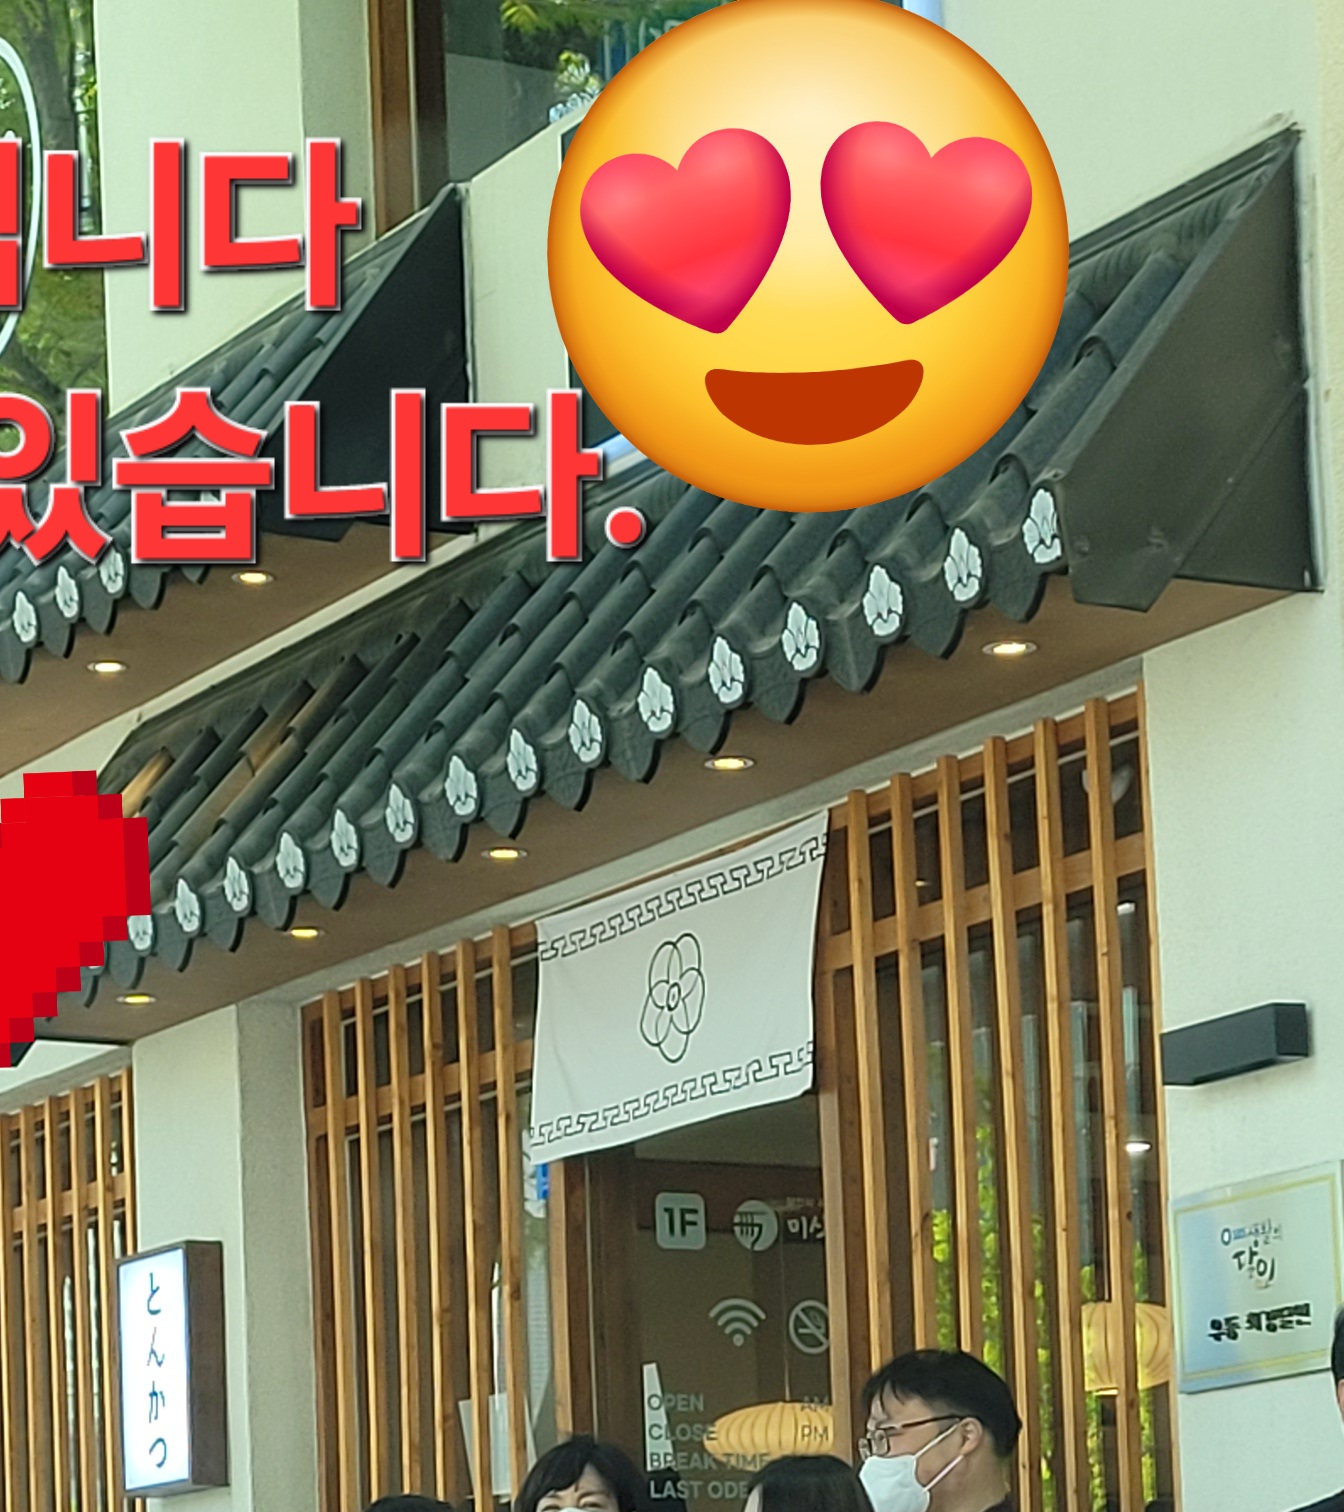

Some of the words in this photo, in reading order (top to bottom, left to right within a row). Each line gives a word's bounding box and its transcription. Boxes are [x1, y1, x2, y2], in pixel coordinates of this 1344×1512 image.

[662, 1207, 699, 1238] 1F
[146, 1272, 168, 1469] とんかつ
[647, 1393, 704, 1412] OPEN
[648, 1423, 719, 1442] CLOSE
[800, 1424, 829, 1442] PM
[650, 1452, 718, 1471] BREAK
[650, 1480, 702, 1500] LAST
